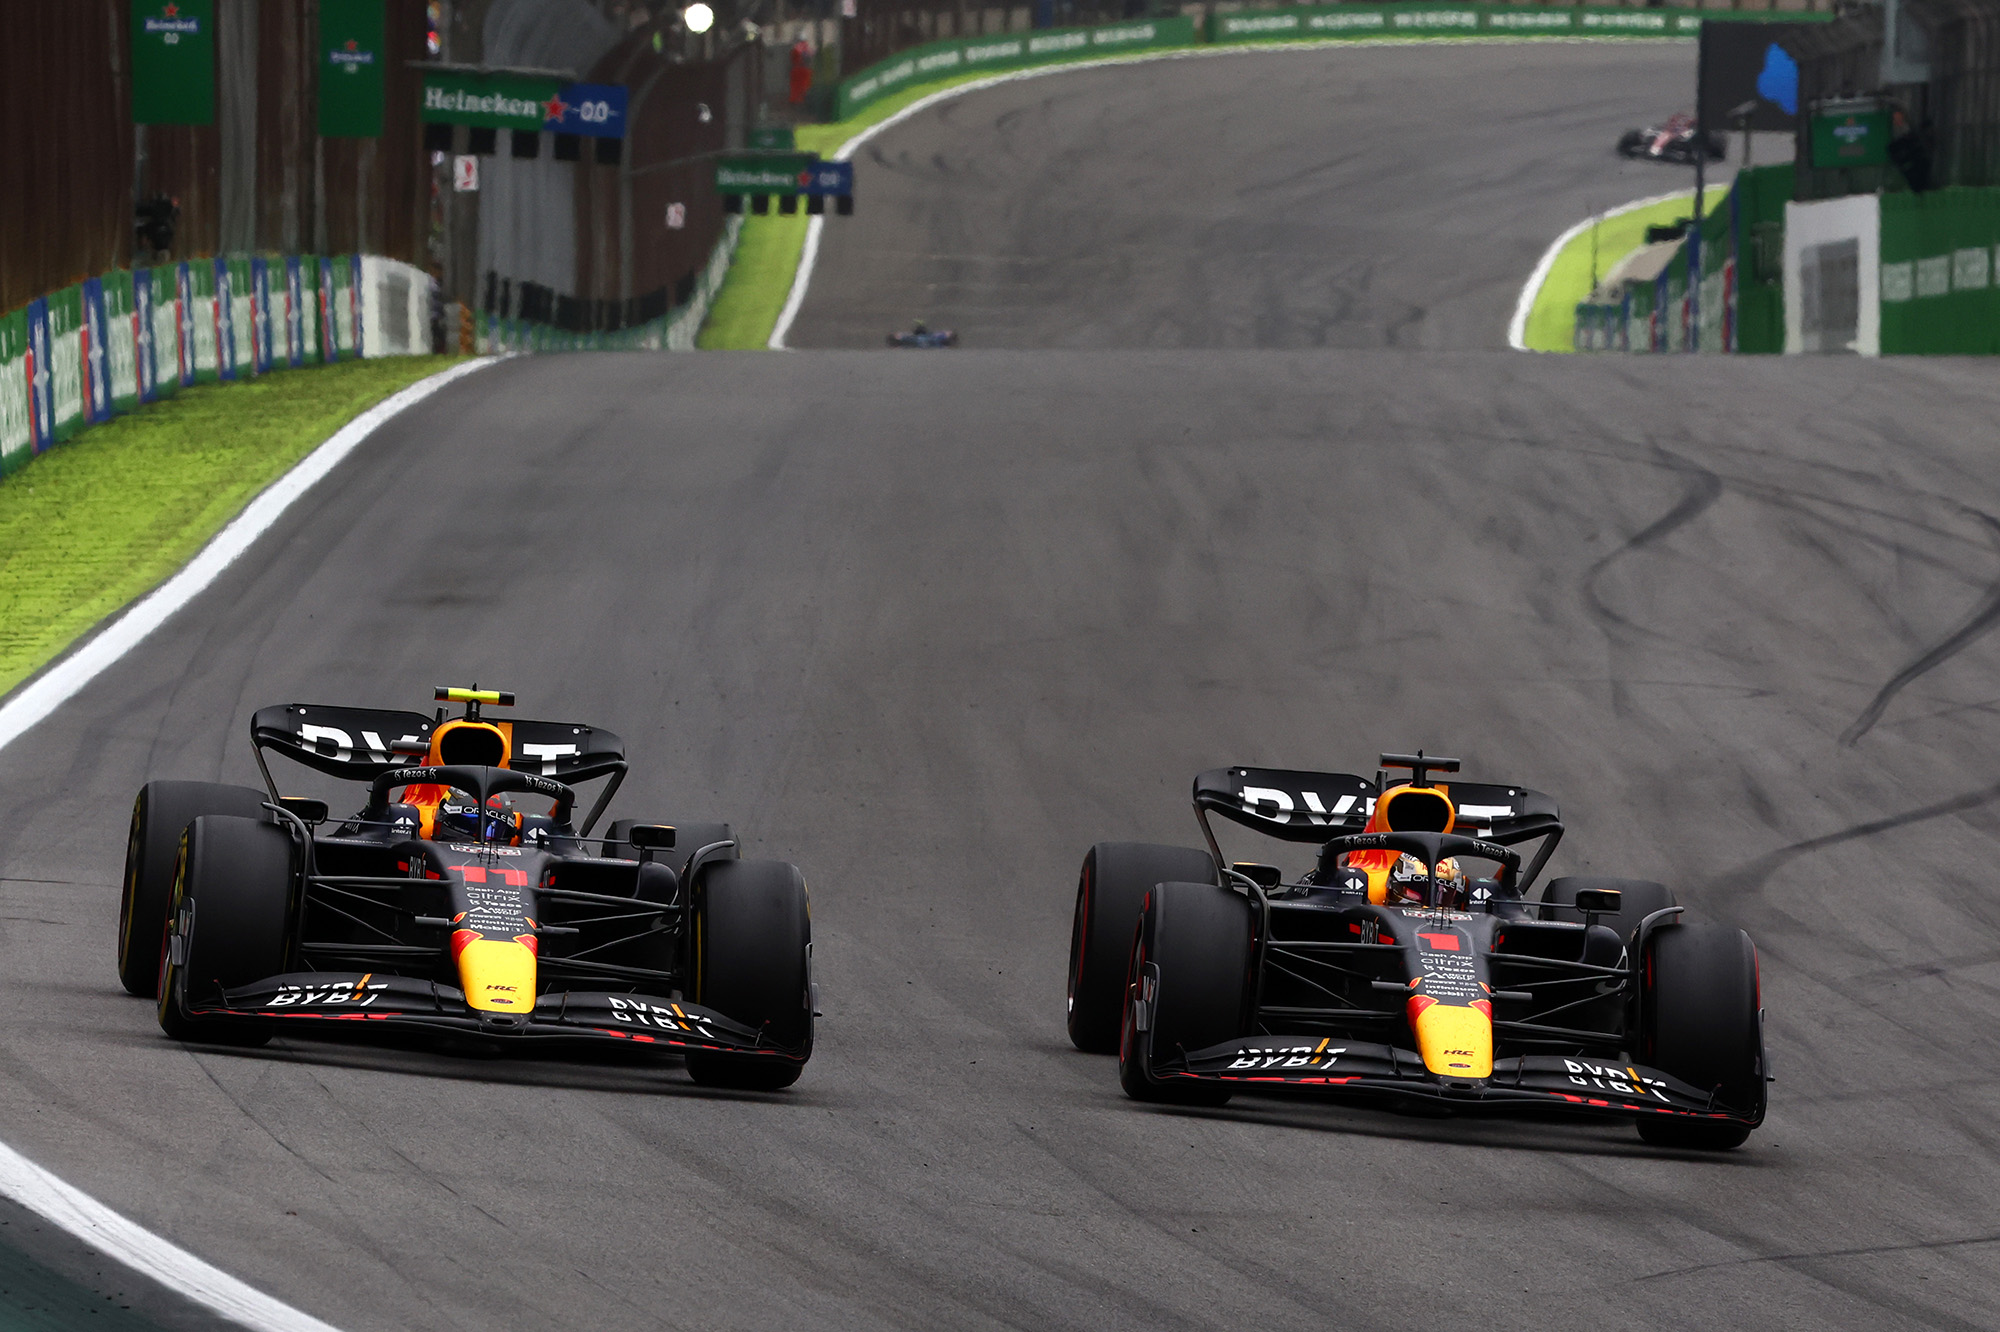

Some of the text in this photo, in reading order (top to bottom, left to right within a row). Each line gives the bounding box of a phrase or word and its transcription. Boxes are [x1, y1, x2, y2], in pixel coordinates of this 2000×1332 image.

[425, 86, 538, 118] Heineken
[402, 769, 427, 778] Tezos
[533, 777, 557, 792] Tezos
[463, 806, 507, 823] ORCLE
[1352, 836, 1377, 845] Tezos
[1481, 844, 1504, 857] Tezos
[447, 865, 528, 886] 11
[1413, 874, 1456, 889] ORCLE
[1417, 933, 1460, 951] 1
[266, 974, 388, 1006] BYBIT
[1227, 1037, 1347, 1070] BYBIT
